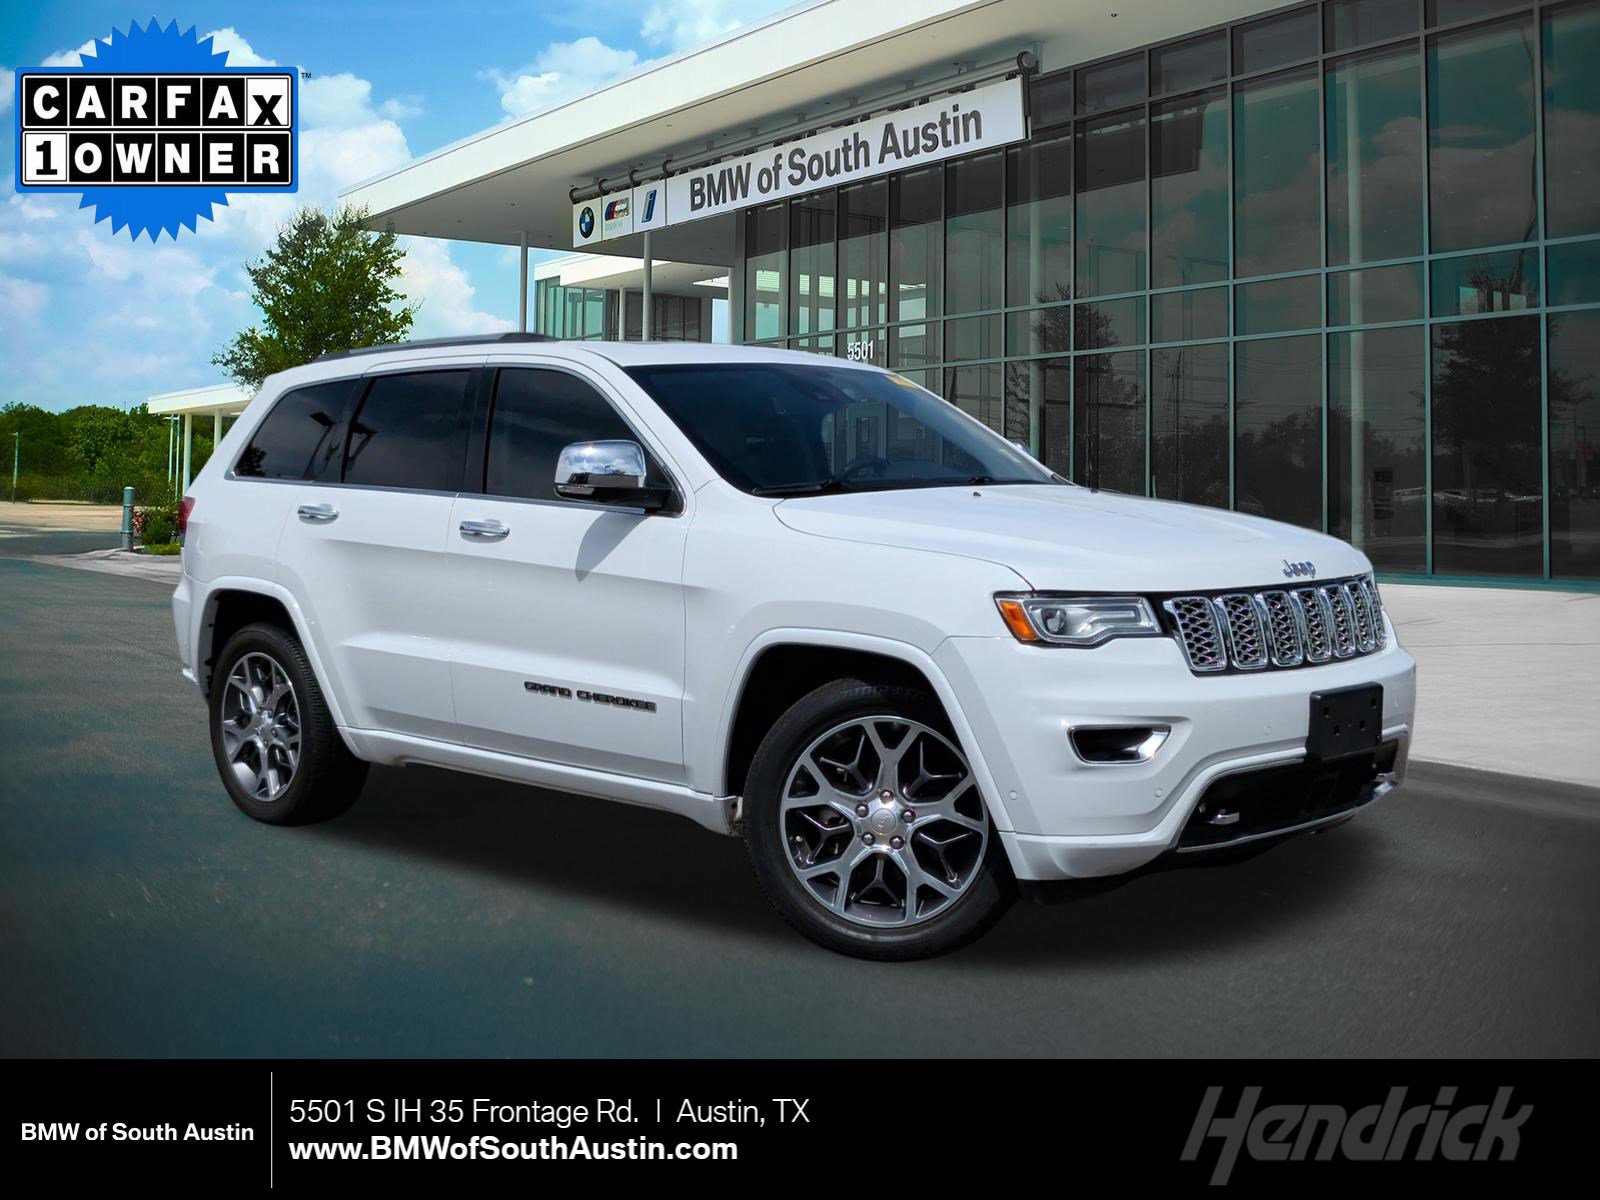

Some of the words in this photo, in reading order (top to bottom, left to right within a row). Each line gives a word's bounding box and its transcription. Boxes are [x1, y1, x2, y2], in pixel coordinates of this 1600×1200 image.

[690, 162, 751, 212] BMW
[757, 153, 783, 194] of
[787, 132, 871, 187] South
[878, 103, 983, 165] Austin
[847, 340, 874, 360] 5501
[1283, 559, 1316, 579] Jeep
[524, 681, 572, 698] GRAND
[576, 689, 657, 713] CHEROKEE
